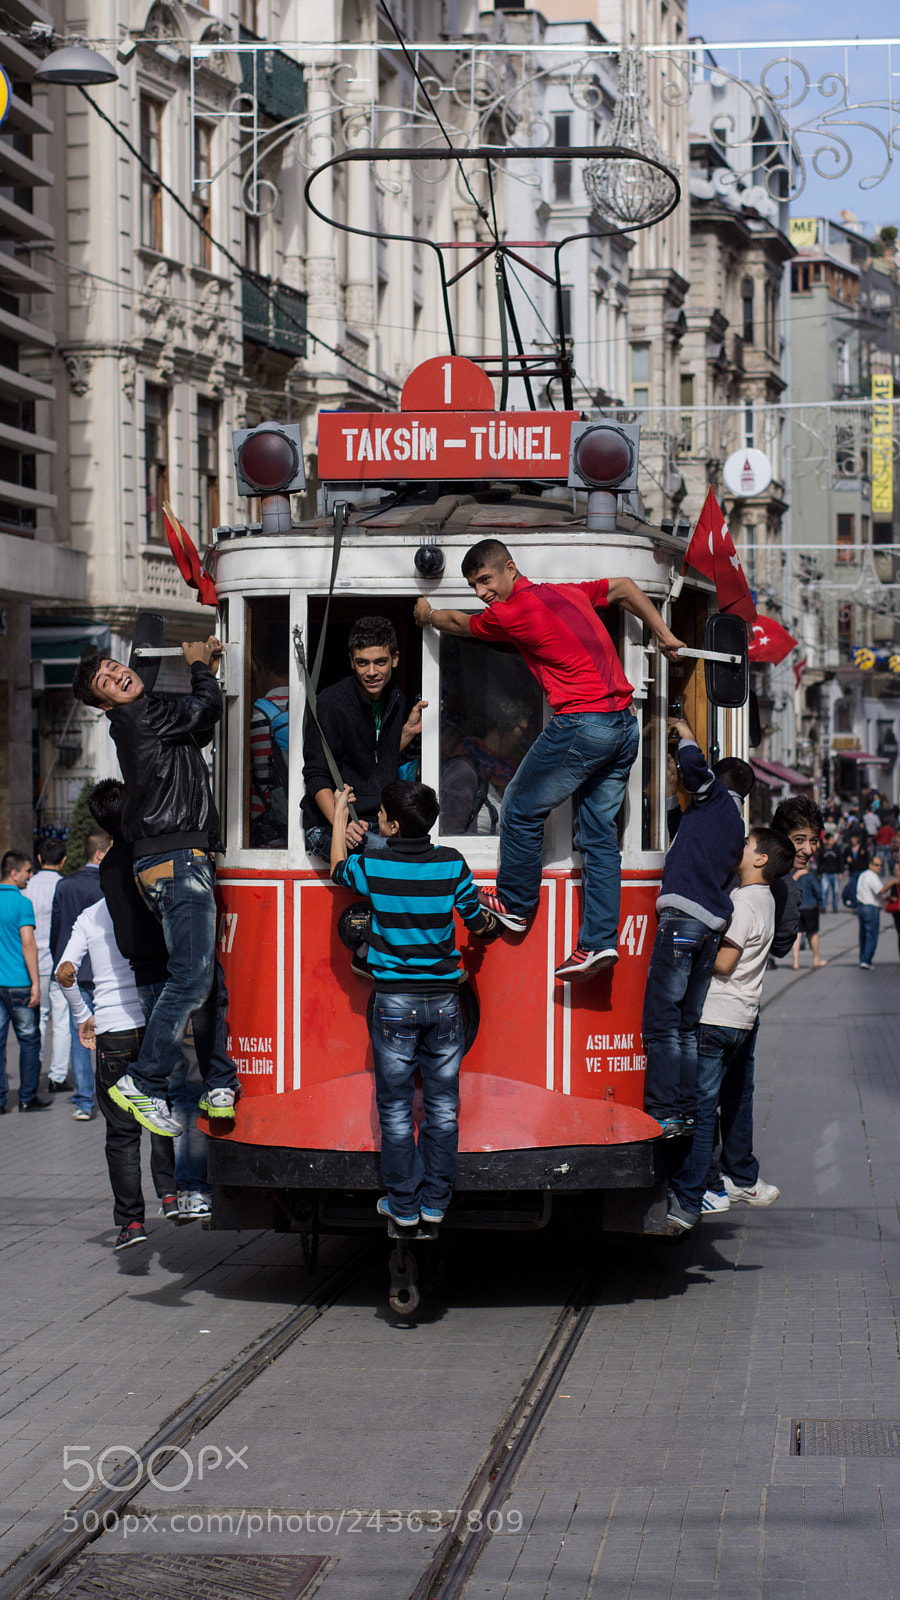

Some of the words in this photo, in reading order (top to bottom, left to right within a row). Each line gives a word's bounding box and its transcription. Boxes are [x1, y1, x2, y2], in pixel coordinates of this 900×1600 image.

[441, 362, 452, 404] 1
[342, 421, 437, 461] TAKSİM
[470, 420, 561, 460] TÜNEL
[218, 912, 238, 953] 47
[620, 914, 648, 956] 47
[238, 1036, 273, 1052] YASAK
[586, 1033, 634, 1050] ASILMAK
[585, 1057, 602, 1073] VE
